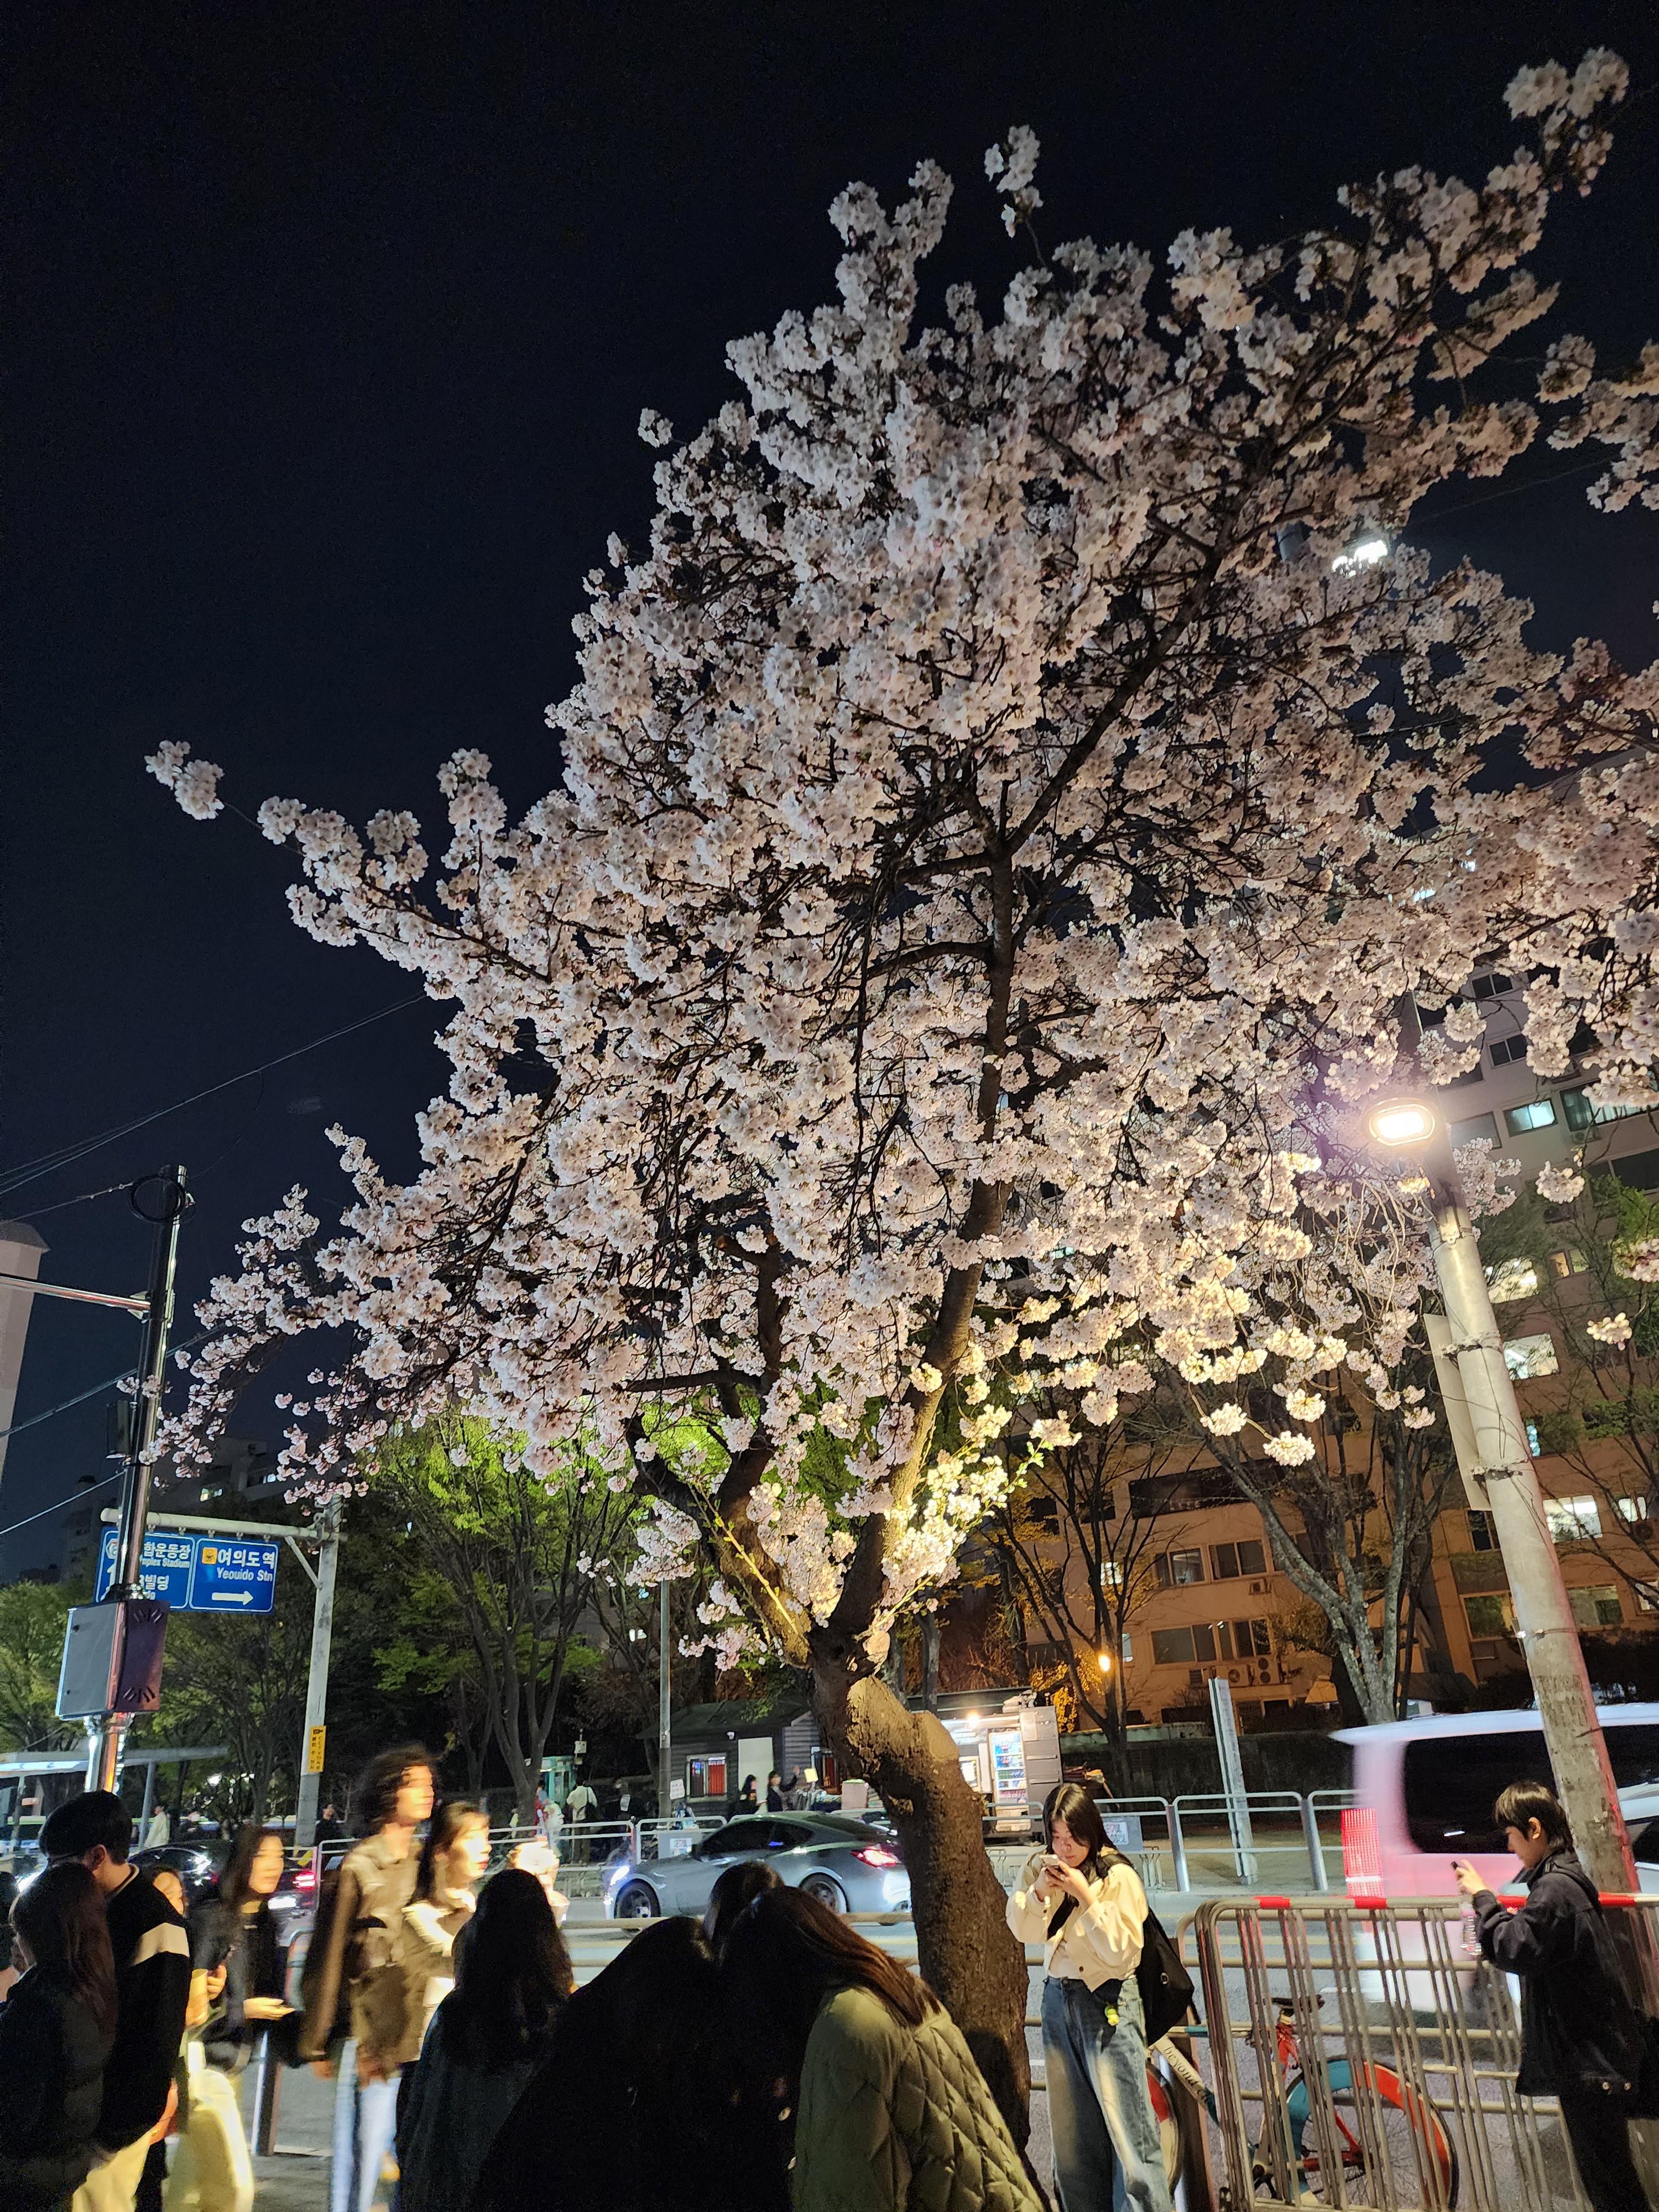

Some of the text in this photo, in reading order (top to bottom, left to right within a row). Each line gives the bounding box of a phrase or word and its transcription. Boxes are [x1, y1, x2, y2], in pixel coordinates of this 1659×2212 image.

[143, 1541, 191, 1559] 합운동장
[217, 1548, 275, 1569] 여의도역
[162, 1557, 190, 1568] Stadium
[139, 1574, 170, 1590] 3빌딩
[216, 1567, 273, 1582] Yeouido Stn
[1164, 2047, 1200, 2086] beyond
